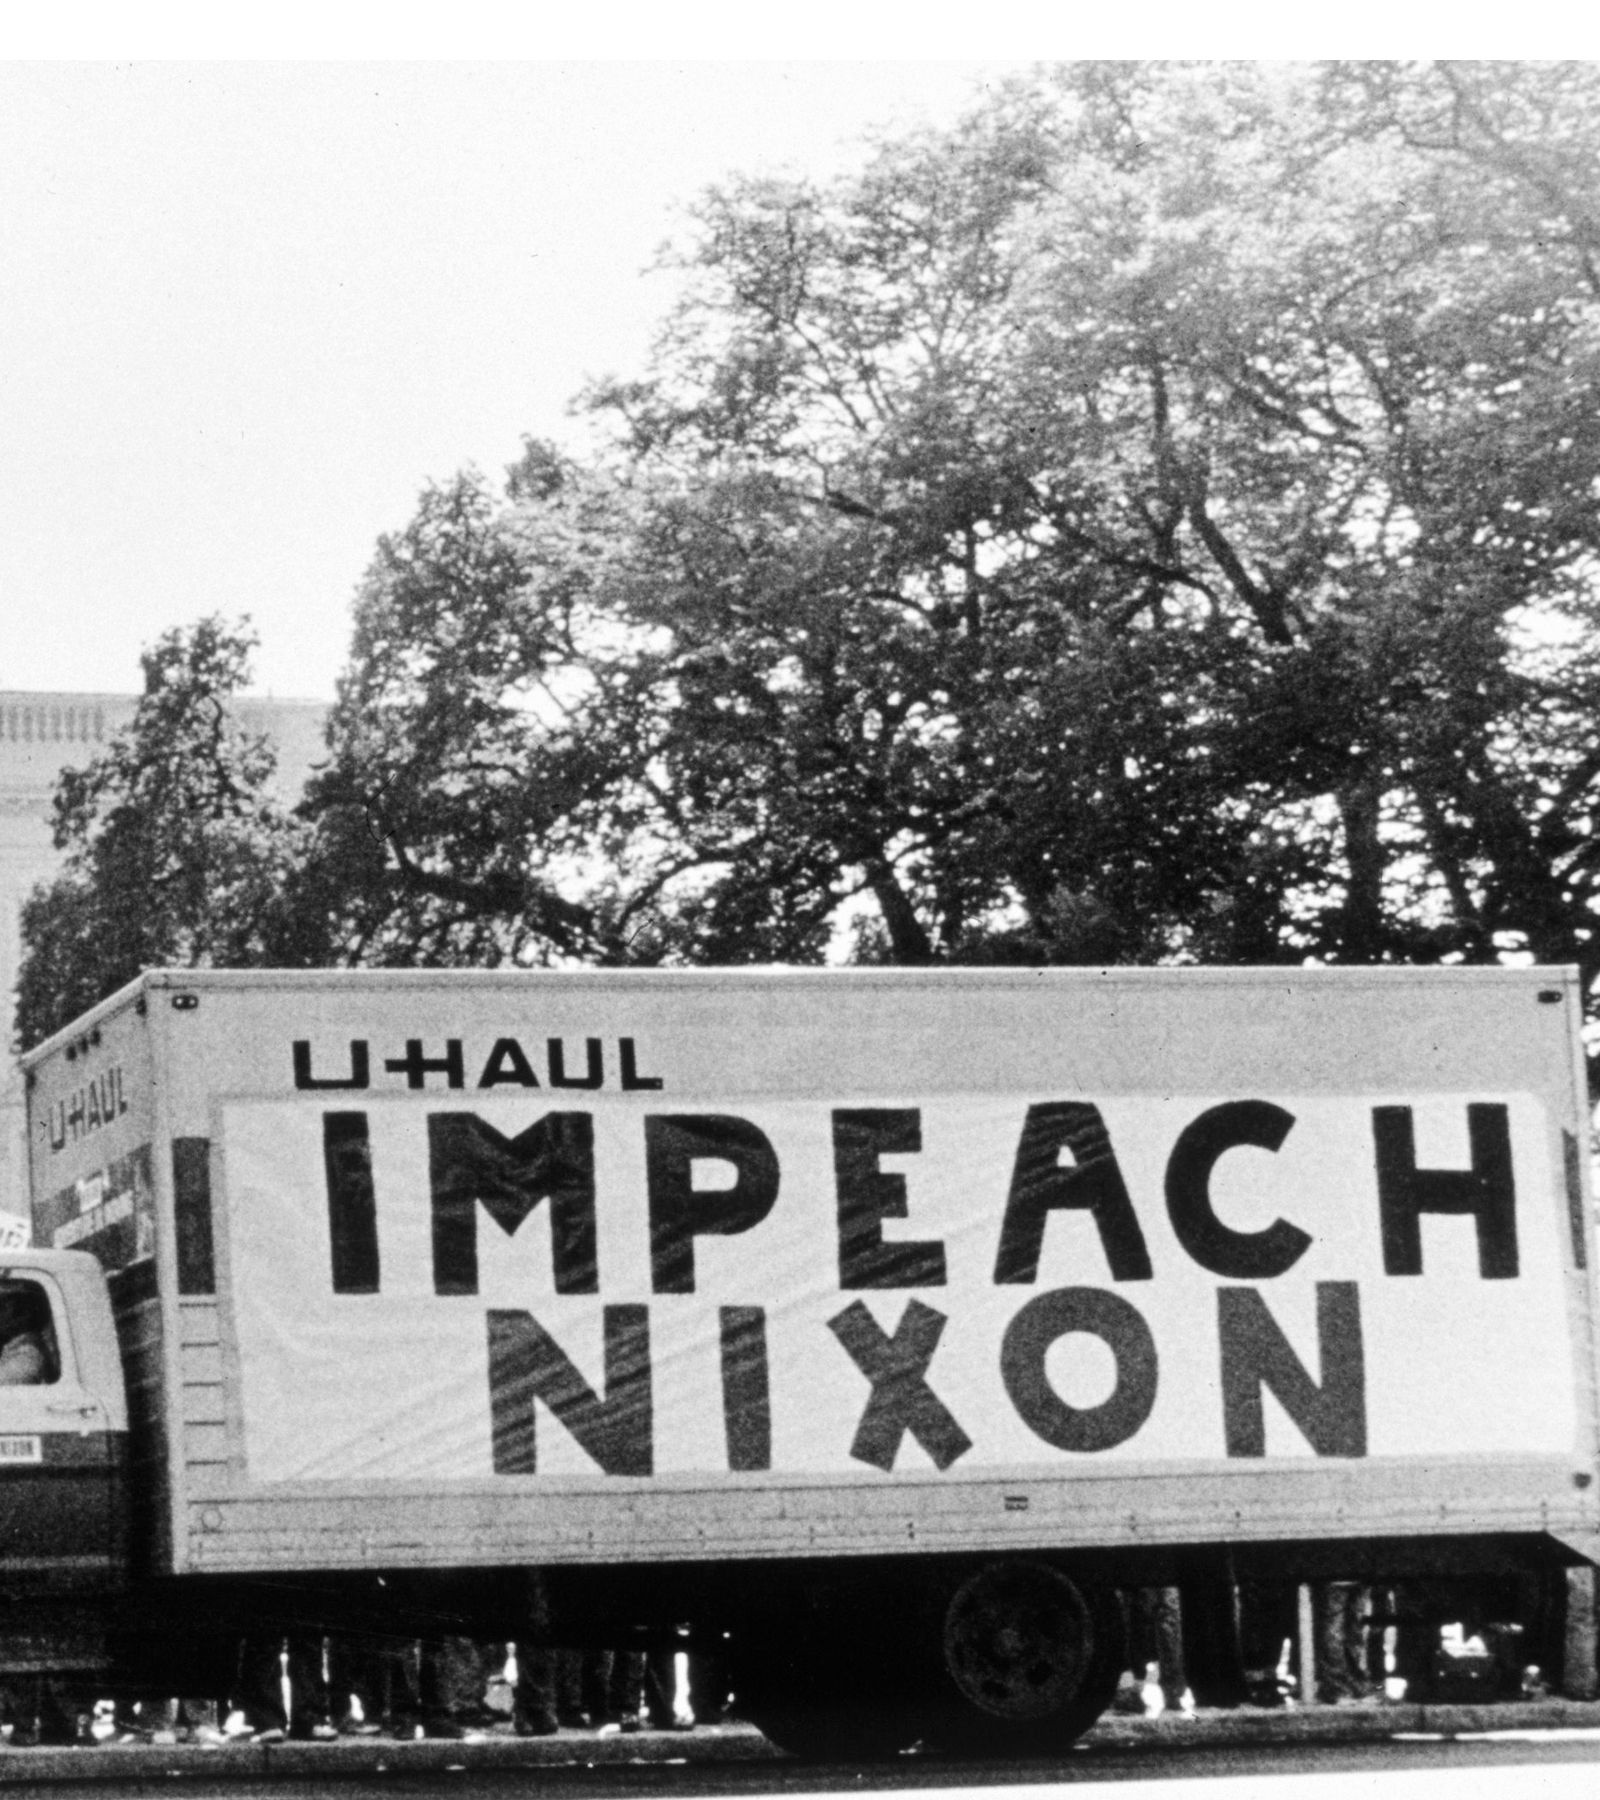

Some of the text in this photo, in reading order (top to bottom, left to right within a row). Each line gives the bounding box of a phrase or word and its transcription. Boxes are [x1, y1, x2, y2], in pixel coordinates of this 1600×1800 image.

[292, 1036, 664, 1091] U-HAUL
[322, 1098, 1522, 1295] IMPEACH
[485, 1280, 1368, 1478] NIXON
